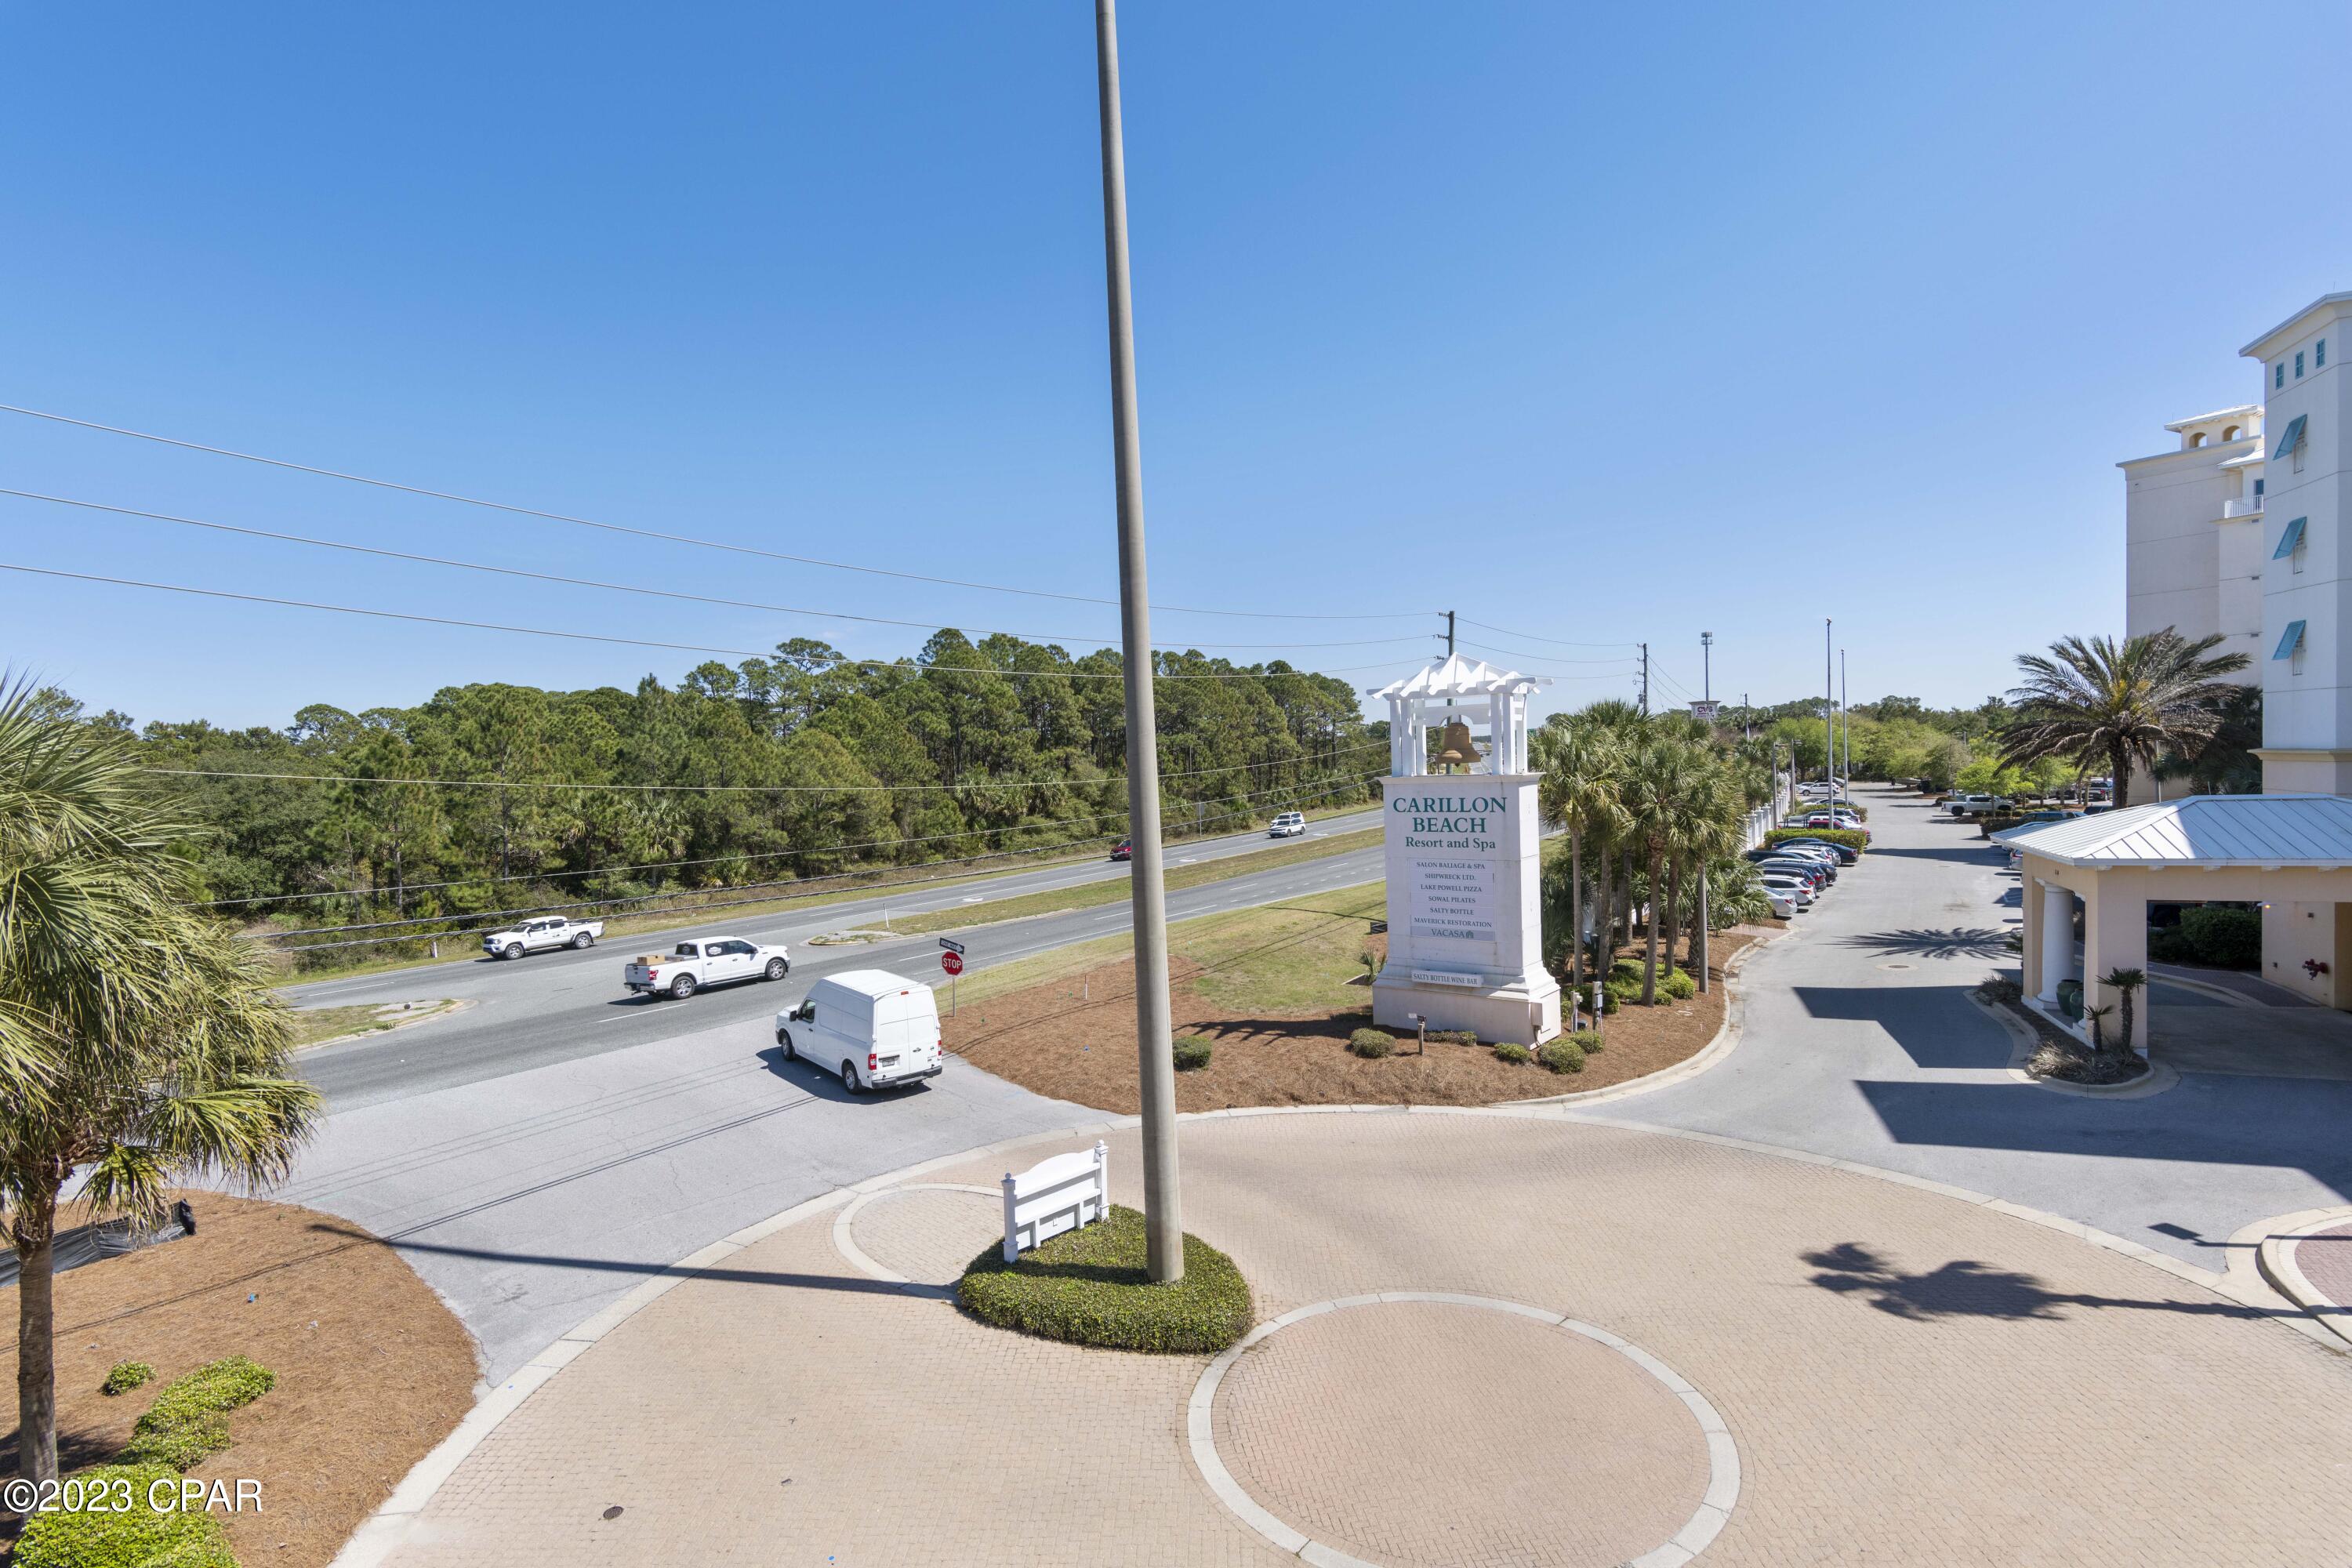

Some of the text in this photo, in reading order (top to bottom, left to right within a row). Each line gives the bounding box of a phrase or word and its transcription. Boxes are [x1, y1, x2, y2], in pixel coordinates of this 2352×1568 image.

[1392, 797, 1507, 813] CARILLON
[1412, 817, 1486, 833] BEACH
[1405, 837, 1496, 851] Resort and Spa
[1431, 928, 1465, 938] VACASA
[943, 958, 961, 969] STOP
